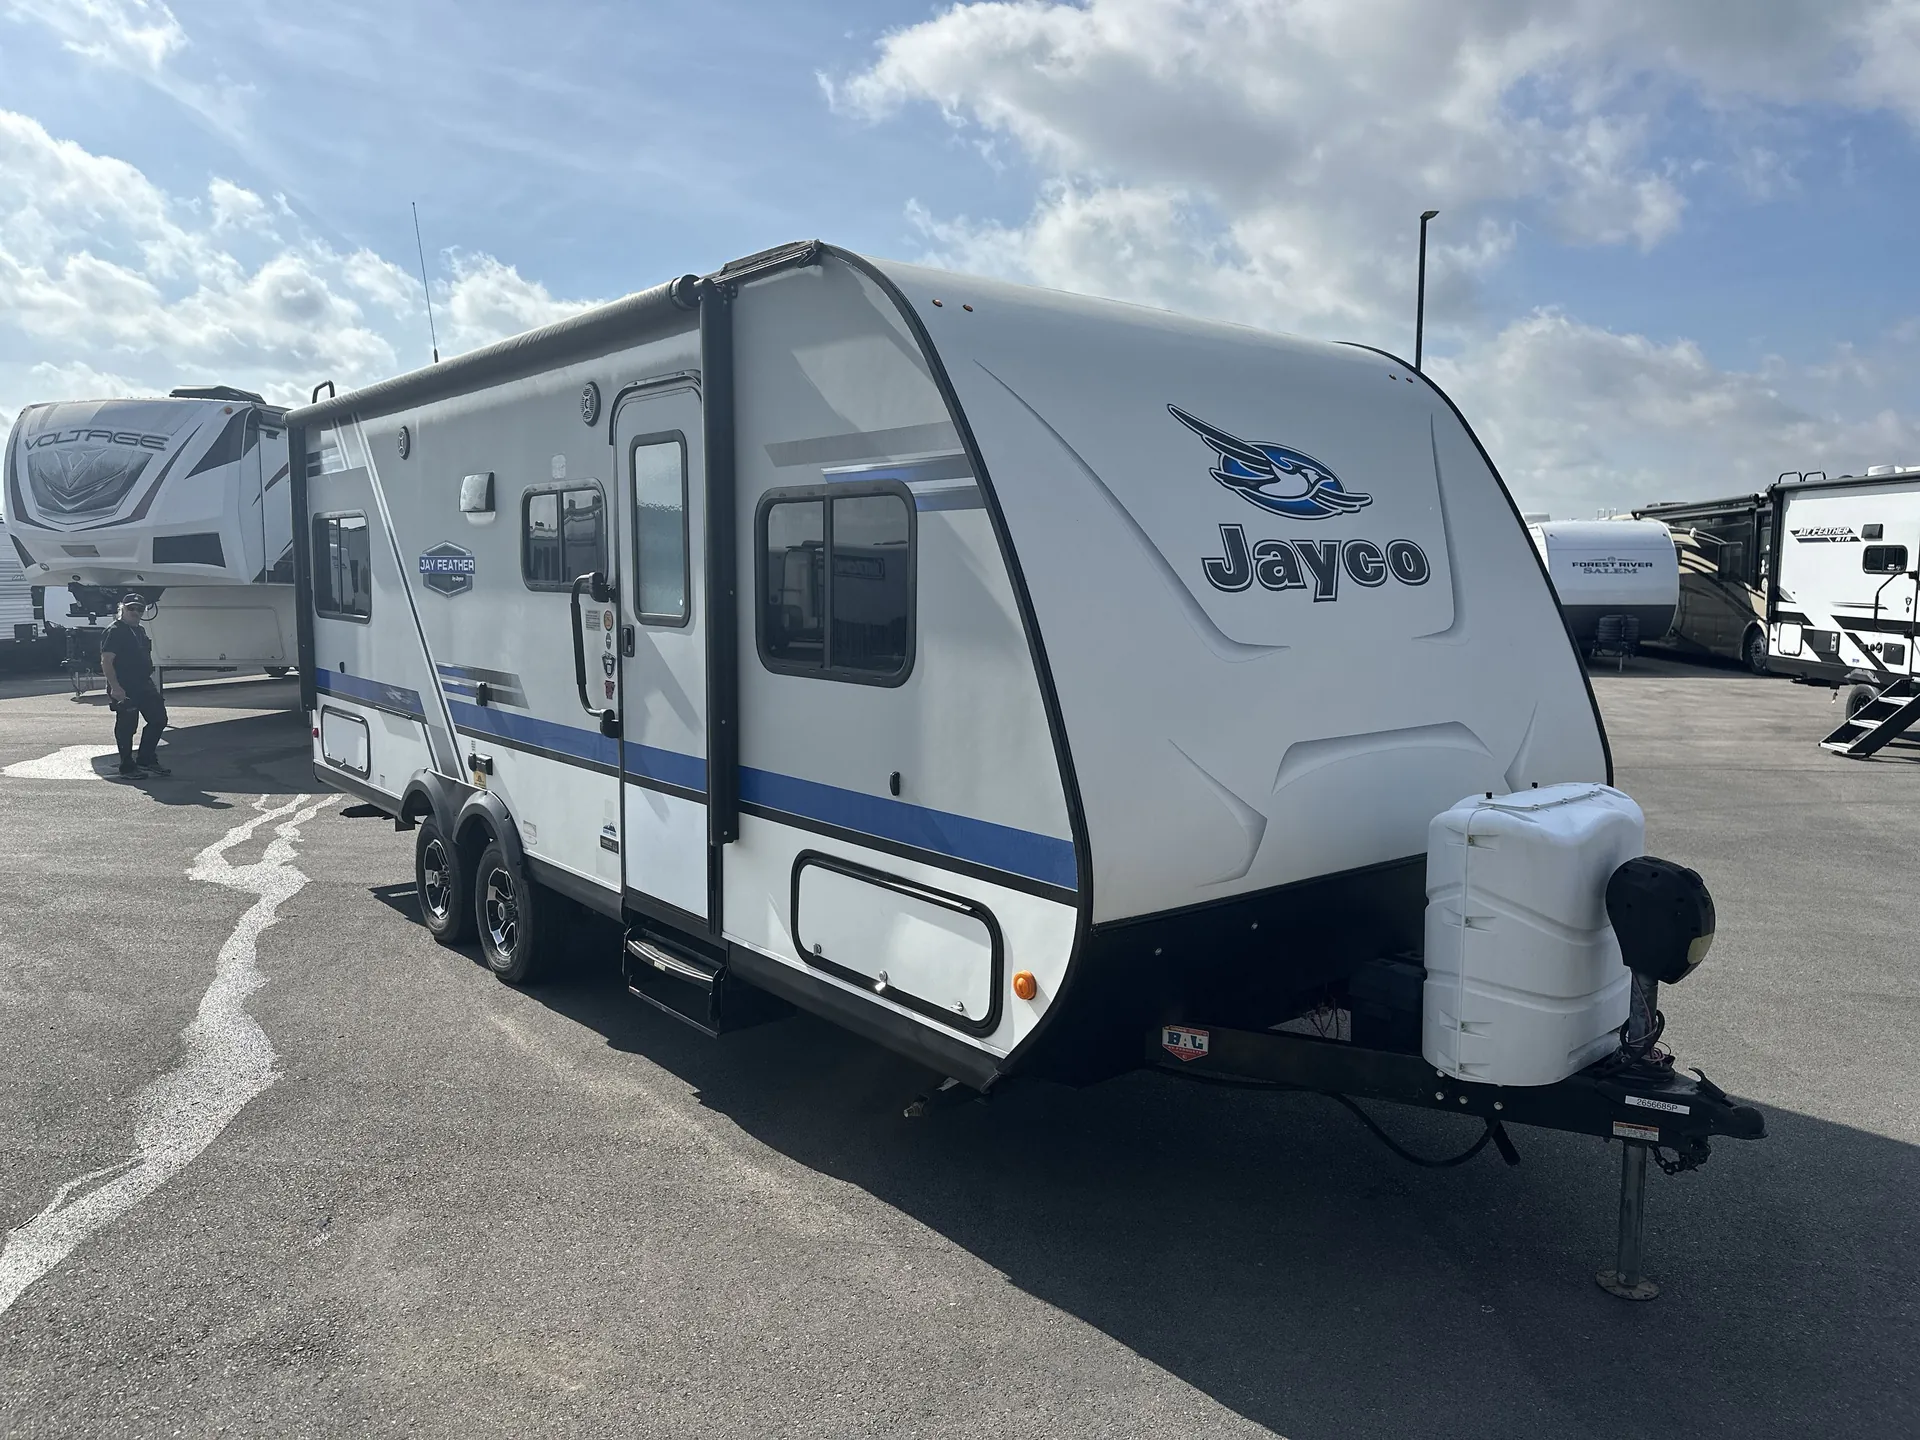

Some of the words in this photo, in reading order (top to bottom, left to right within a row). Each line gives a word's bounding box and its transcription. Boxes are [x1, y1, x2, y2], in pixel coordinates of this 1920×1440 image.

[25, 429, 169, 451] VOLTAGE
[1811, 526, 1850, 536] FEATHER
[420, 559, 436, 571] JAY
[437, 559, 475, 571] FEATHER
[1201, 524, 1430, 602] Jayco
[1637, 1098, 1678, 1111] 2656685P
